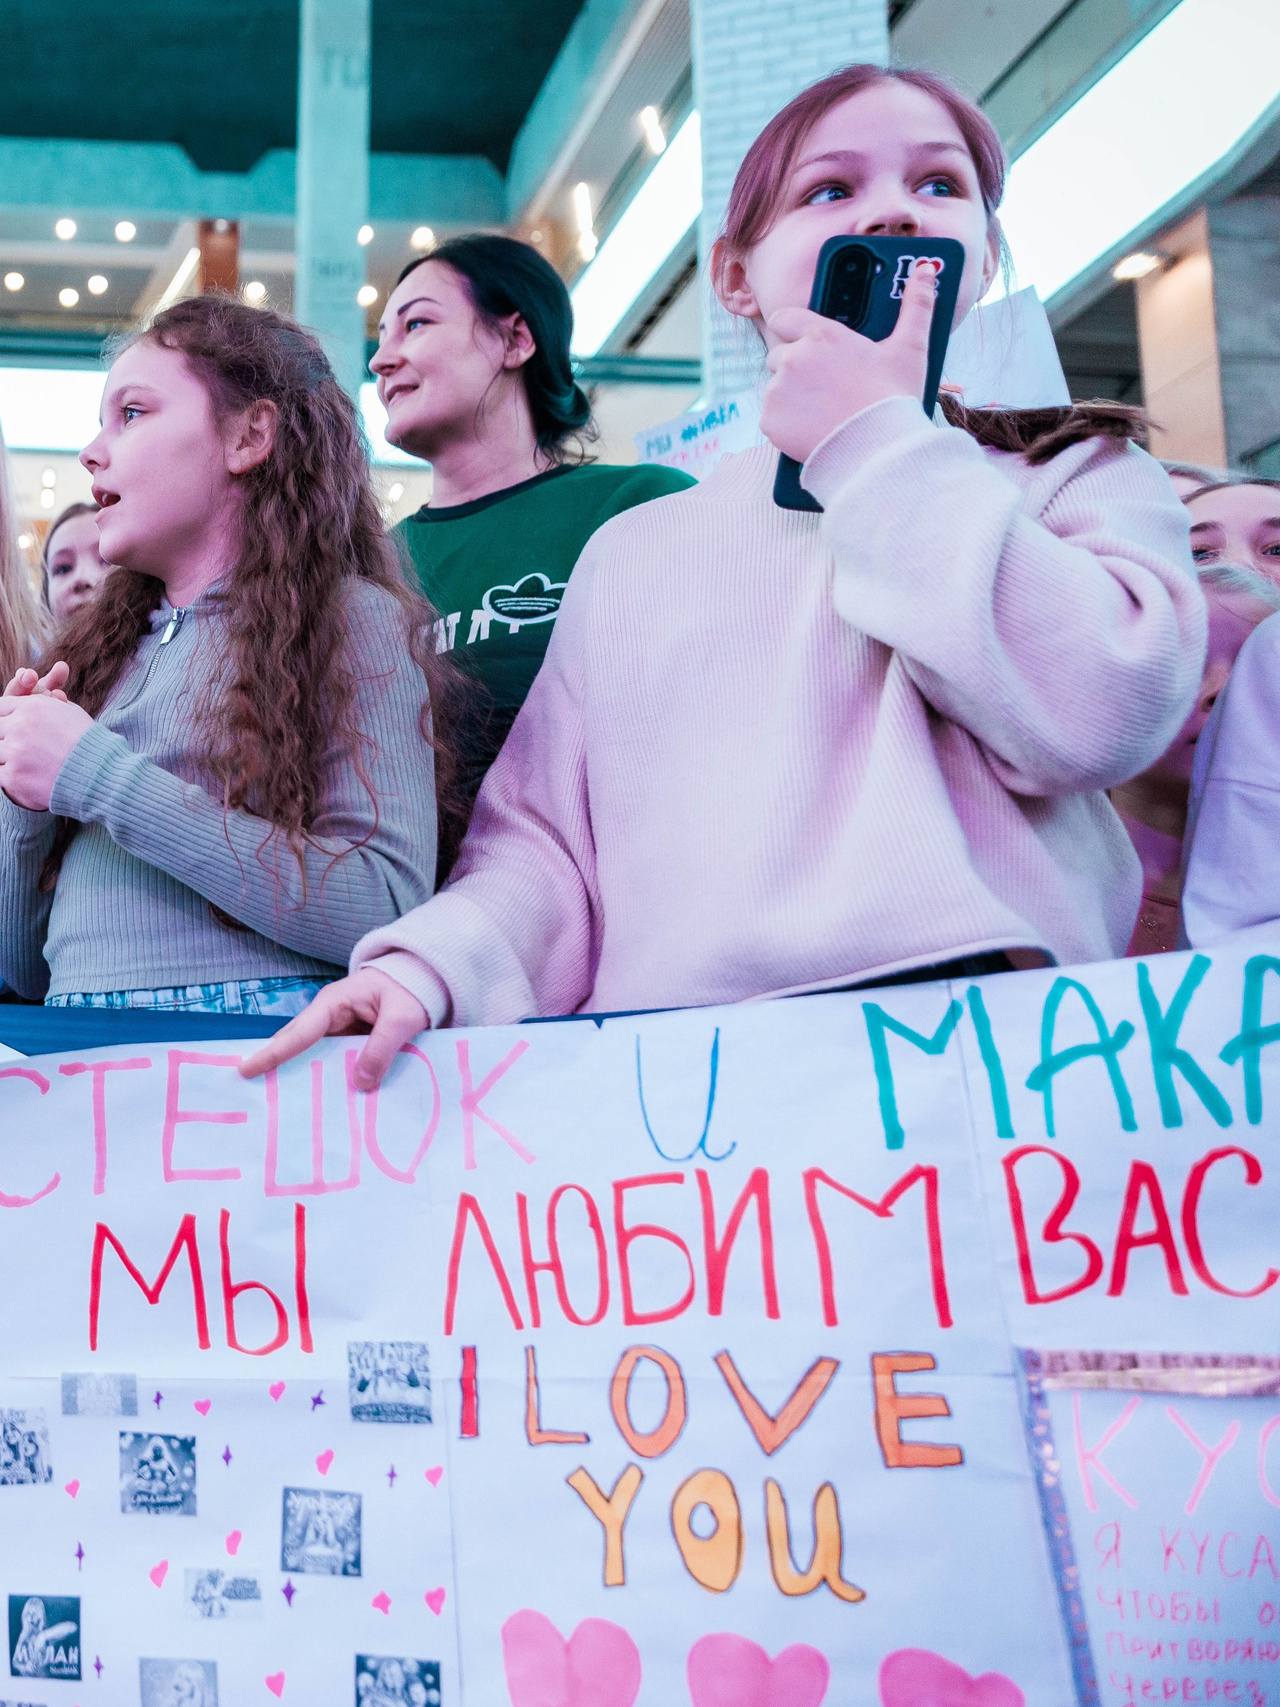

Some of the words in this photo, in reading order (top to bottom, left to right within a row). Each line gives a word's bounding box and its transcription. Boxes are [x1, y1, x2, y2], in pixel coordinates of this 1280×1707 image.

[88, 1202, 314, 1355] МЫ
[443, 1163, 953, 1336] ЛЮБИМ
[1001, 1145, 1280, 1305] ВАС
[524, 1344, 964, 1469] LOVE
[1072, 1391, 1280, 1515] КУ
[566, 1462, 867, 1604] YOU
[1094, 1520, 1122, 1570] Я
